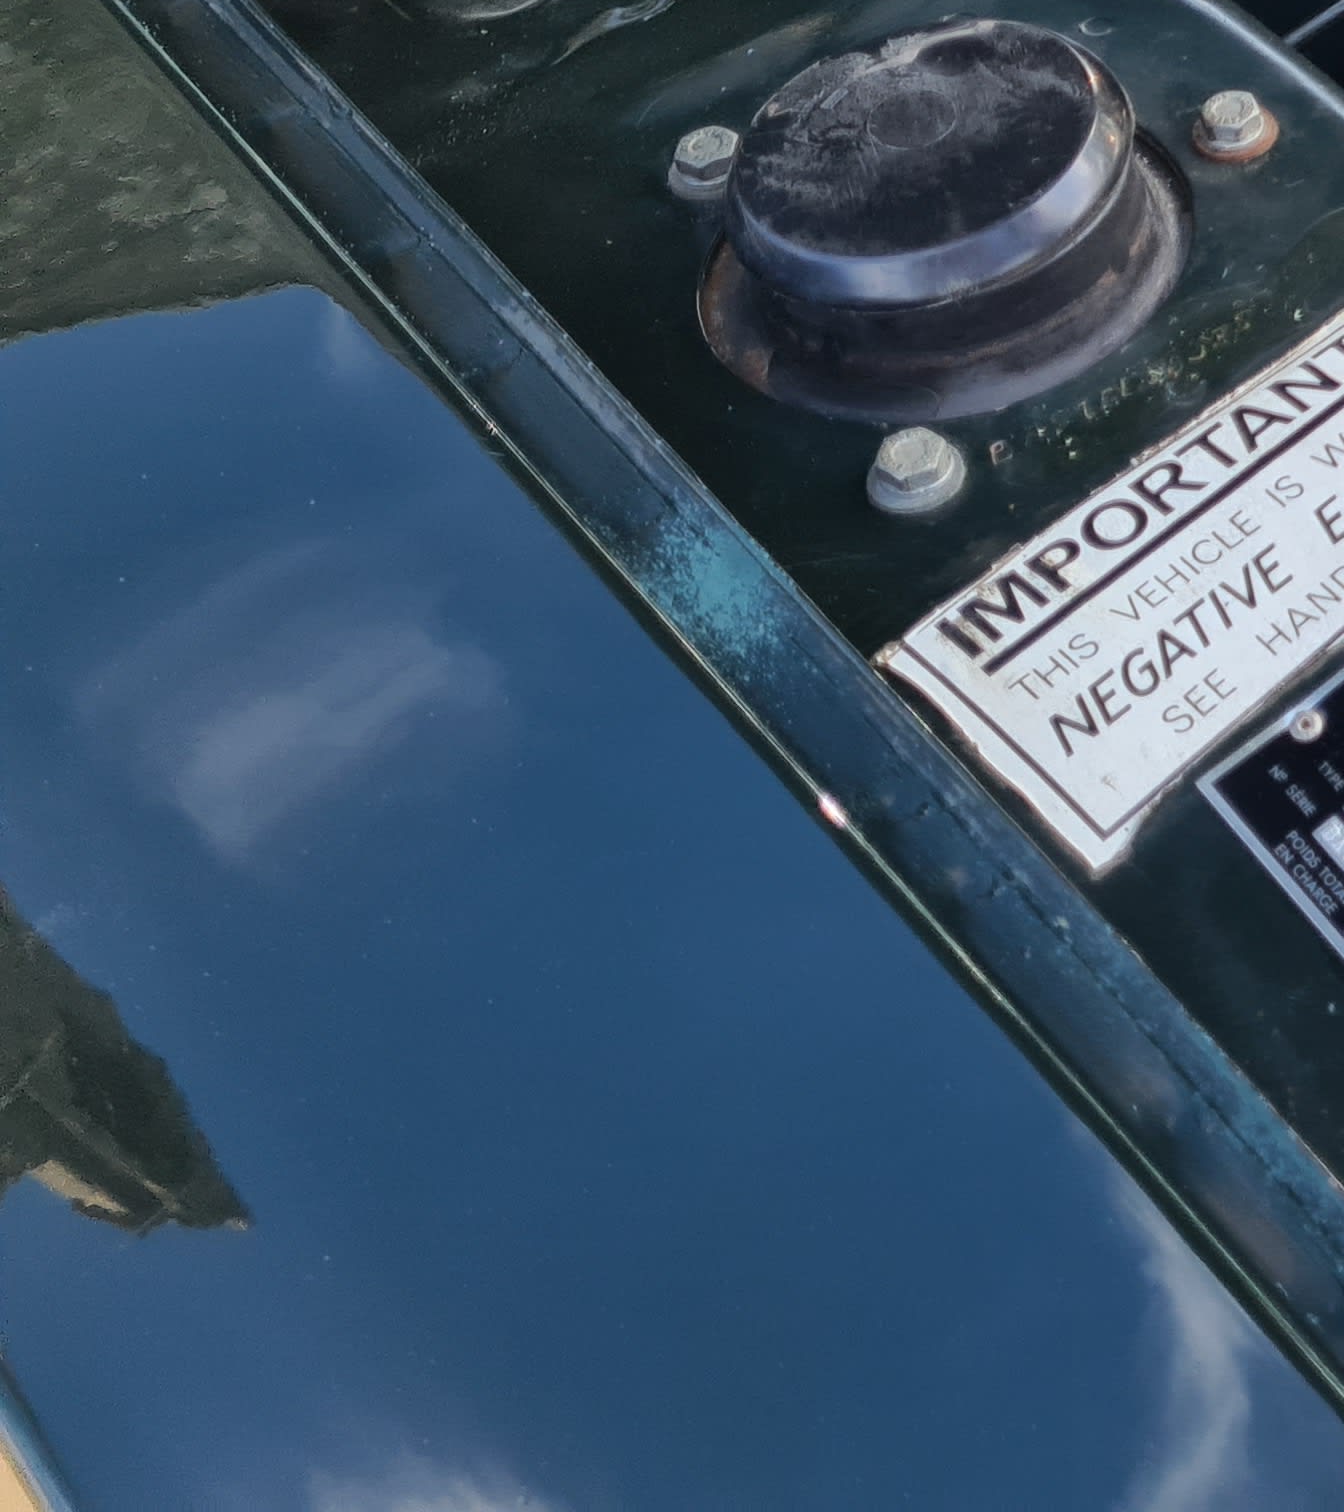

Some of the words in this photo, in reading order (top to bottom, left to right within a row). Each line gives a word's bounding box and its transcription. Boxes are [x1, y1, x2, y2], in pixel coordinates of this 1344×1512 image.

[1009, 632, 1101, 702] THIS
[1110, 509, 1260, 626] VEHICLE
[1266, 476, 1306, 510] IS
[1047, 543, 1294, 758] NEGATIVE
[1160, 668, 1238, 736] SEE
[1272, 840, 1298, 867] EN
[1290, 862, 1340, 916] CHARGE
[1283, 828, 1322, 871] POIDS
